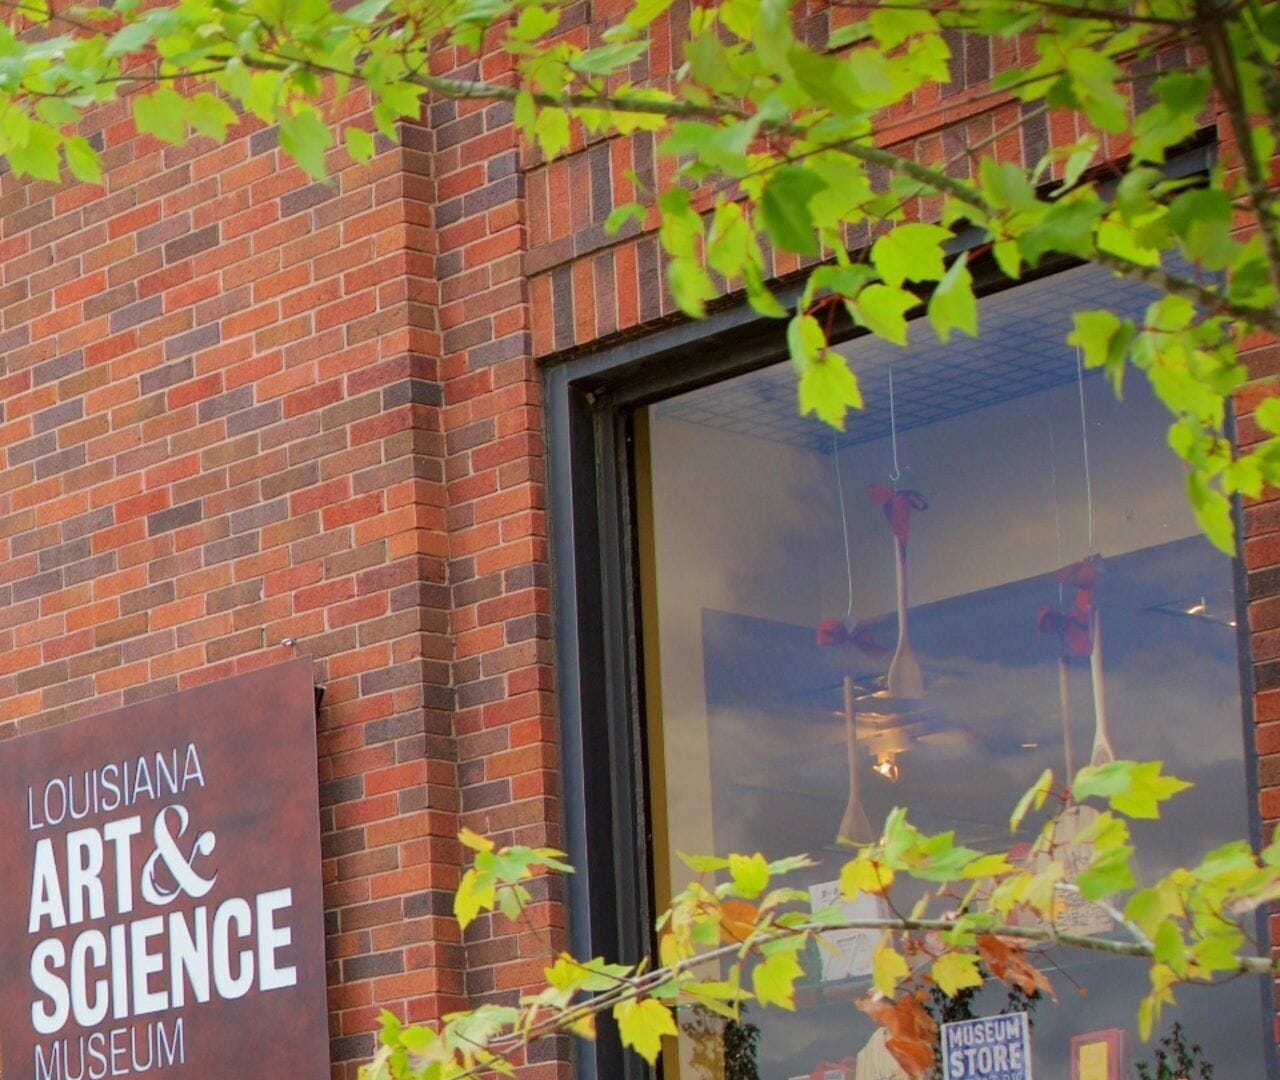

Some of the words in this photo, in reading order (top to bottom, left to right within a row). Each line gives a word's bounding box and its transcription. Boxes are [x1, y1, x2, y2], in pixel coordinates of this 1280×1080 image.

[27, 742, 205, 830] LOUISIANA
[29, 886, 298, 1034] SCIENCE
[949, 1017, 1020, 1048] MUSEUM
[950, 1042, 1022, 1078] STORE
